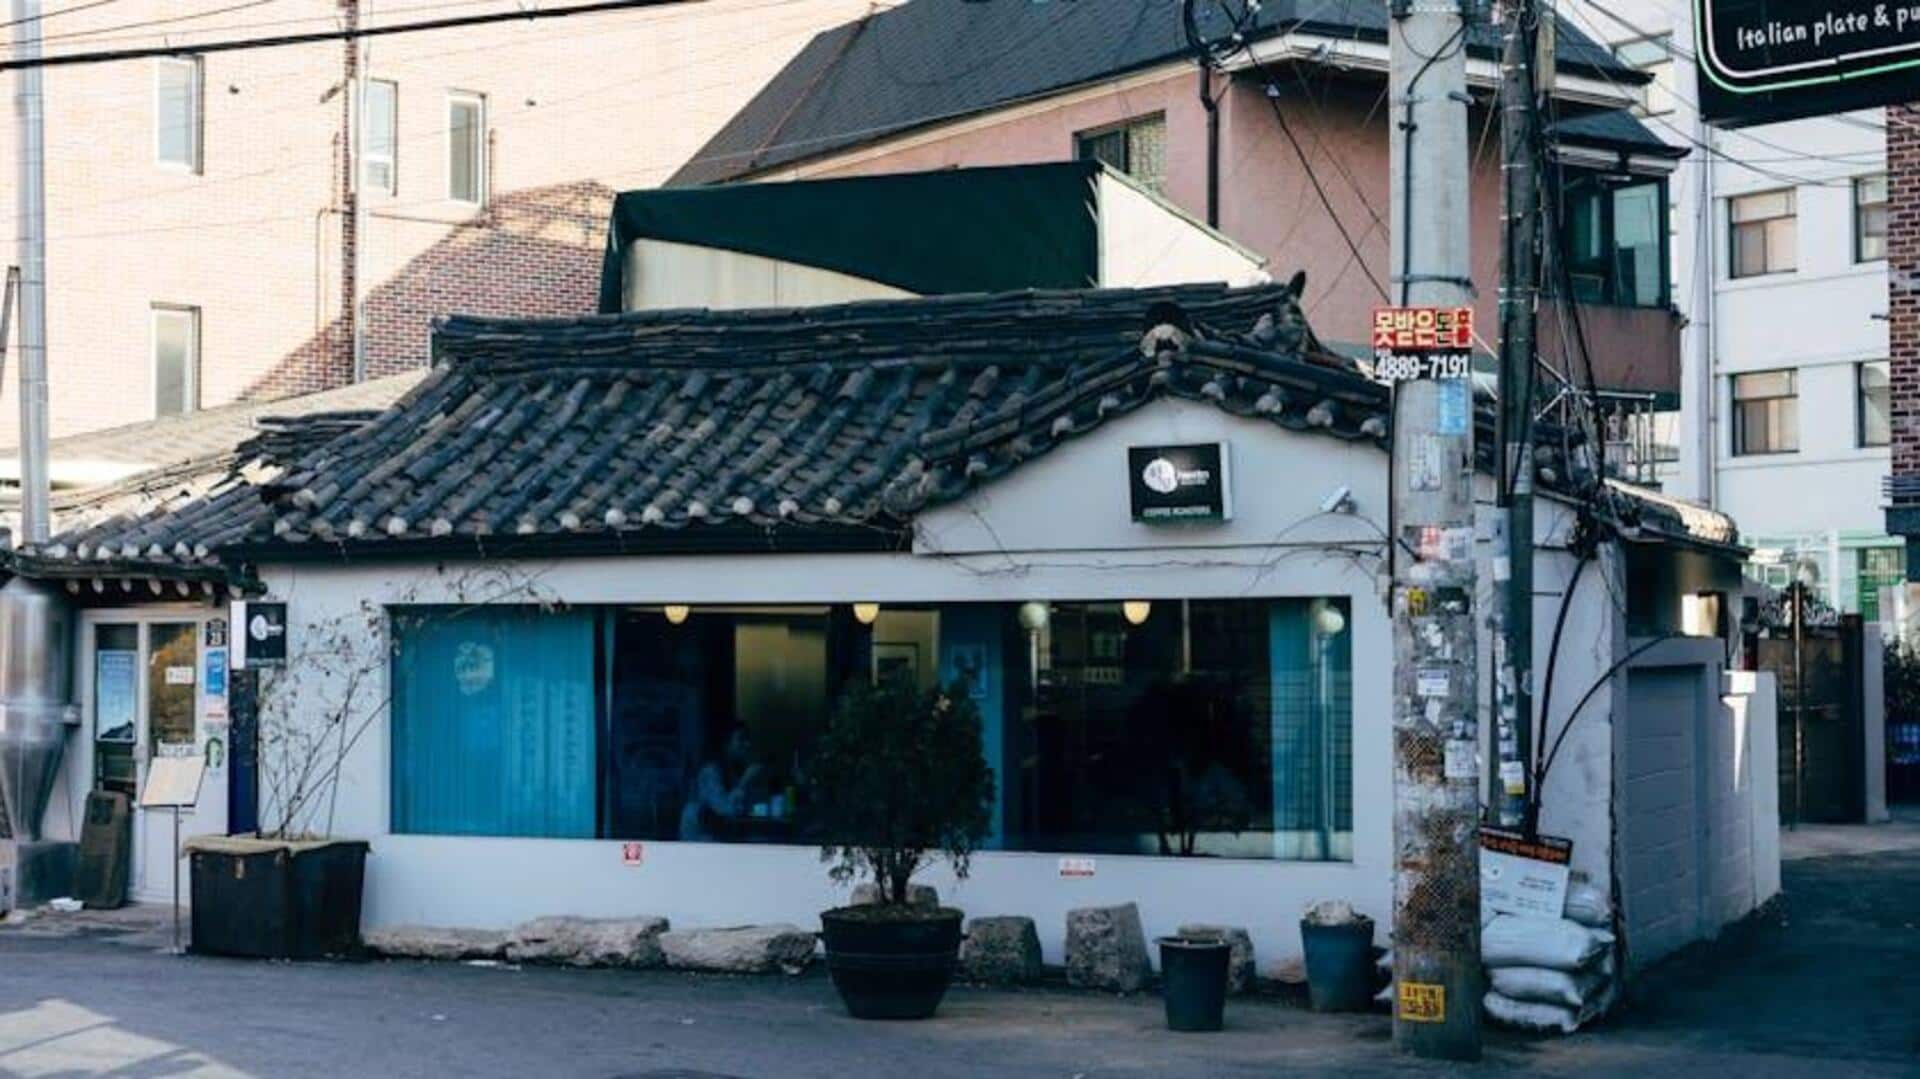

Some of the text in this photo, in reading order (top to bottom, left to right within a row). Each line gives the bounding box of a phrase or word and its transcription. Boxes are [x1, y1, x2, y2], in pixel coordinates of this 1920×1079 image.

[1737, 22, 1807, 51] Italian
[1813, 11, 1869, 46] plate
[1874, 3, 1891, 27] &
[1375, 353, 1470, 379] 4889-7191
